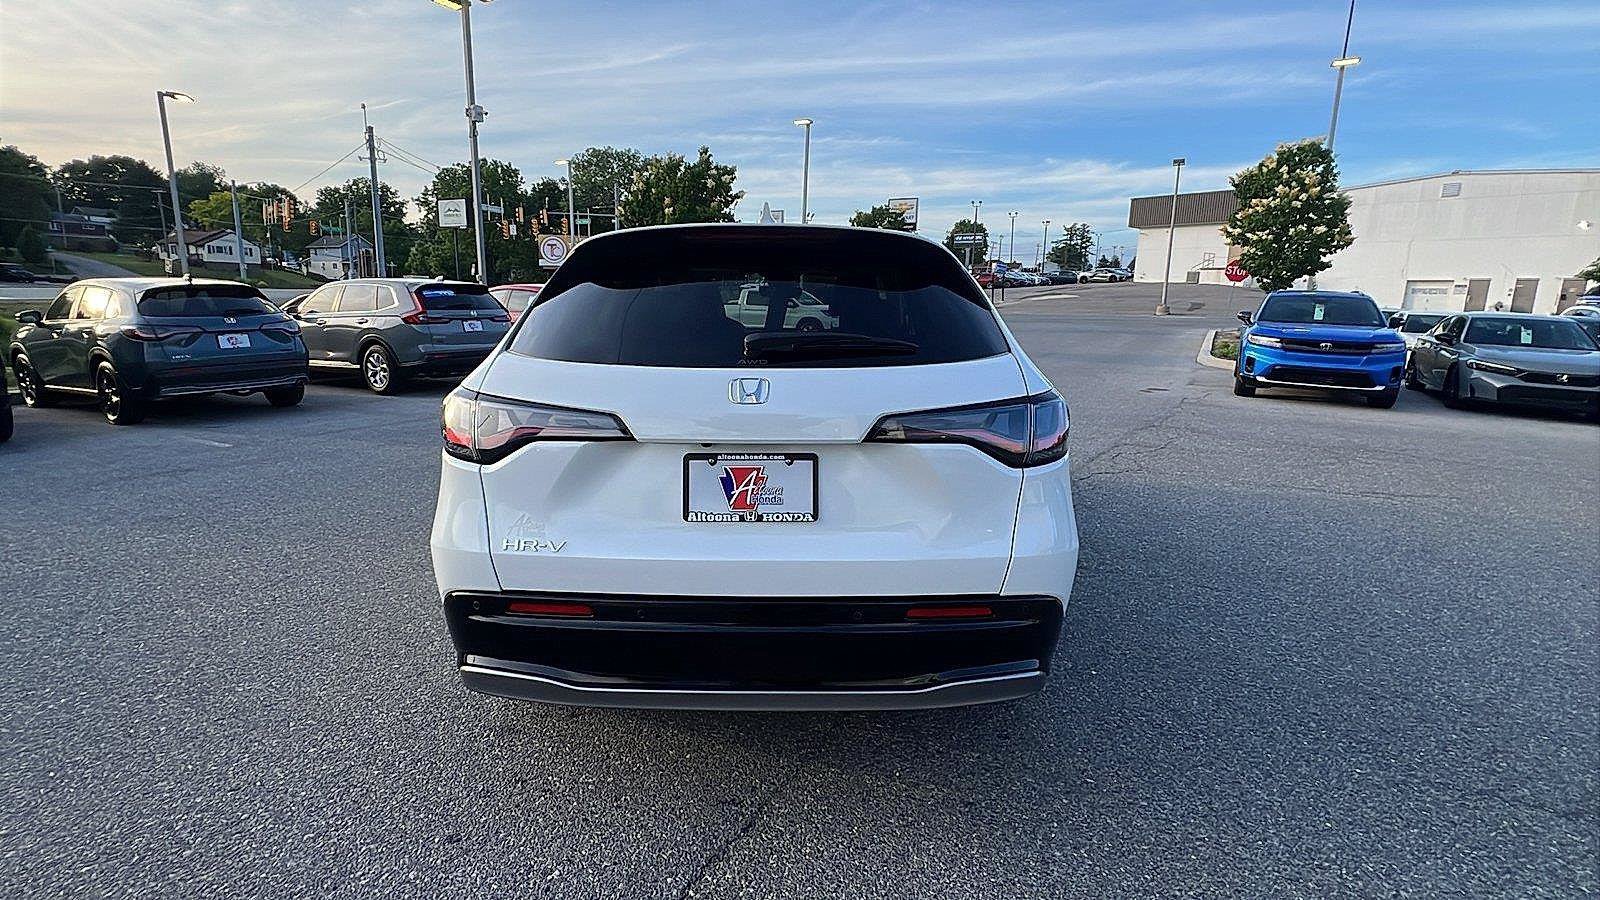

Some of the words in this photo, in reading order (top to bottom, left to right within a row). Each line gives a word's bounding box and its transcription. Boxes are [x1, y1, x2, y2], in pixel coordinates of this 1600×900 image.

[546, 243, 562, 258] TC
[751, 495, 784, 505] Honda
[688, 512, 740, 522] Altoona
[762, 512, 814, 522] HONDA
[502, 539, 567, 553] HR-V
